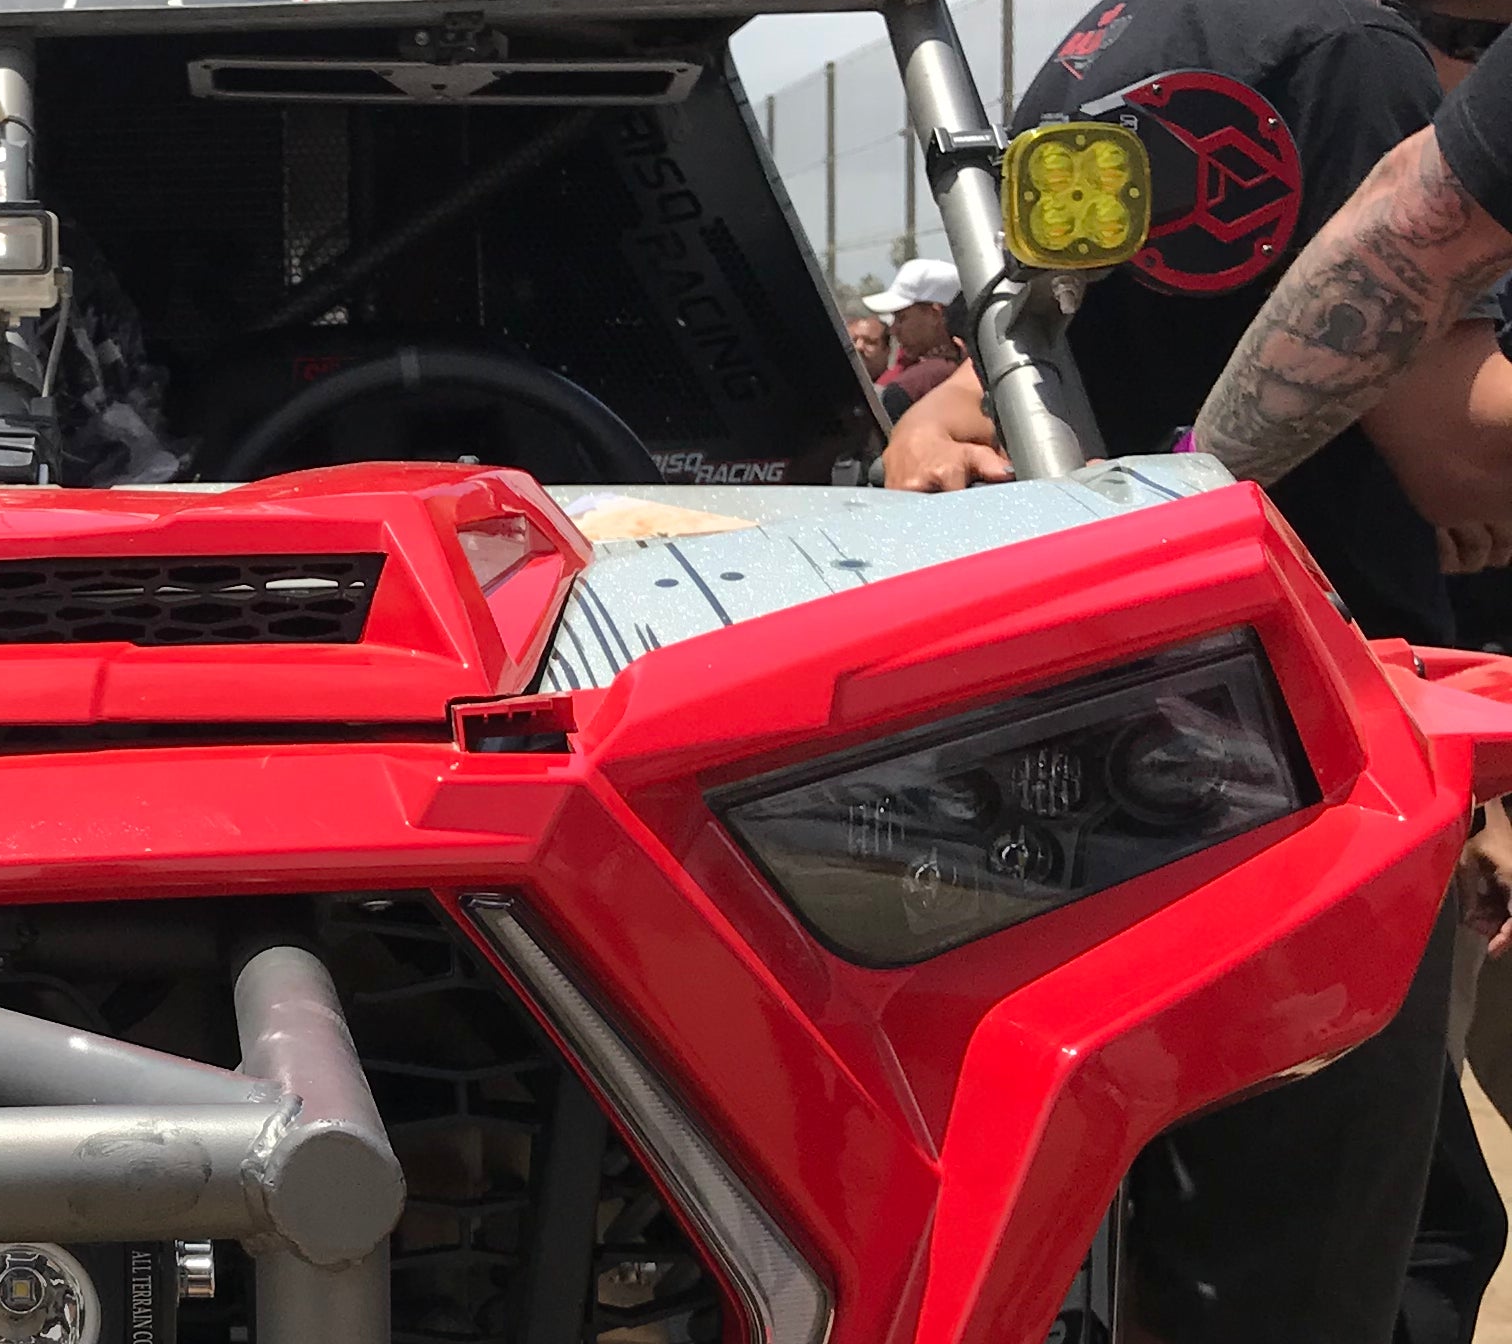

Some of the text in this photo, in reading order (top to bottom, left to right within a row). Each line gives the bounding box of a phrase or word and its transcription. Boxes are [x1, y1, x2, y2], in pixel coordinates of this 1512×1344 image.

[637, 230, 770, 402] RACING
[695, 462, 786, 484] RACING
[132, 1249, 152, 1274] ALL
[132, 1275, 153, 1328] TERRAIN
